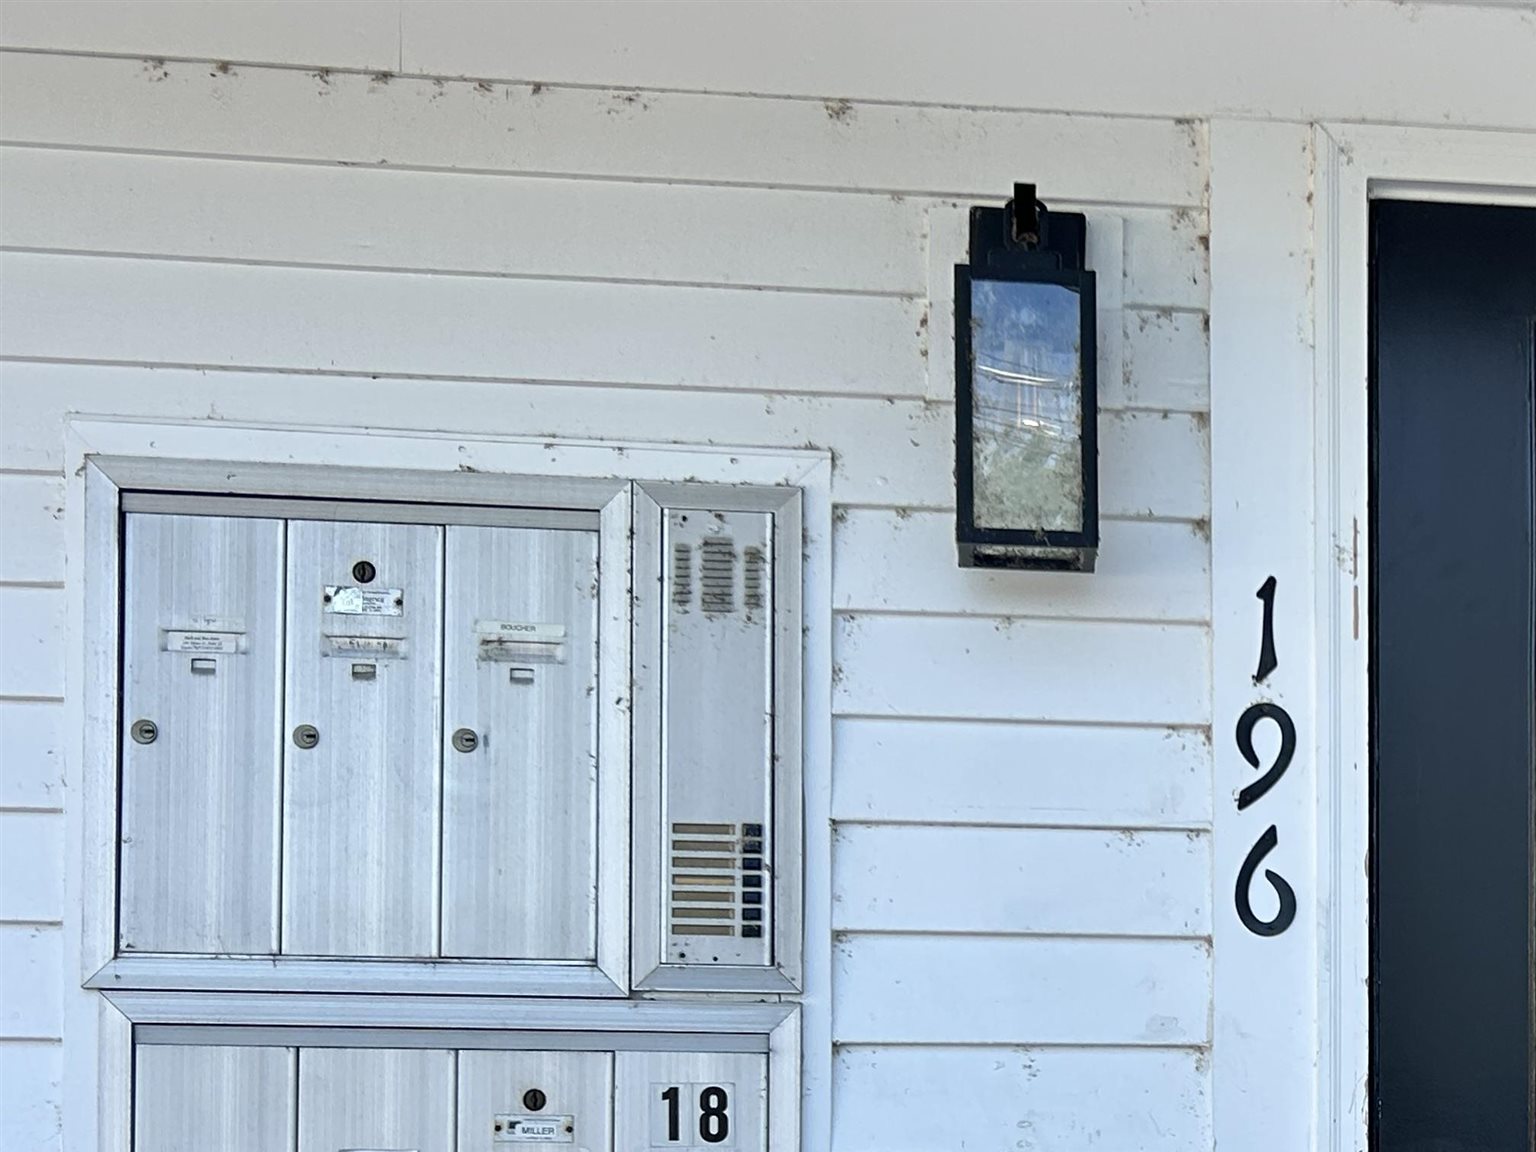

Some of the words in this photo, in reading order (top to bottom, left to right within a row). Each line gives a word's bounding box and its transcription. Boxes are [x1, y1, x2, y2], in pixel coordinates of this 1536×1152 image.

[500, 624, 537, 632] BOUCHER
[1235, 576, 1296, 936] 196
[662, 1087, 728, 1142] 18
[521, 1127, 555, 1135] MILLER
